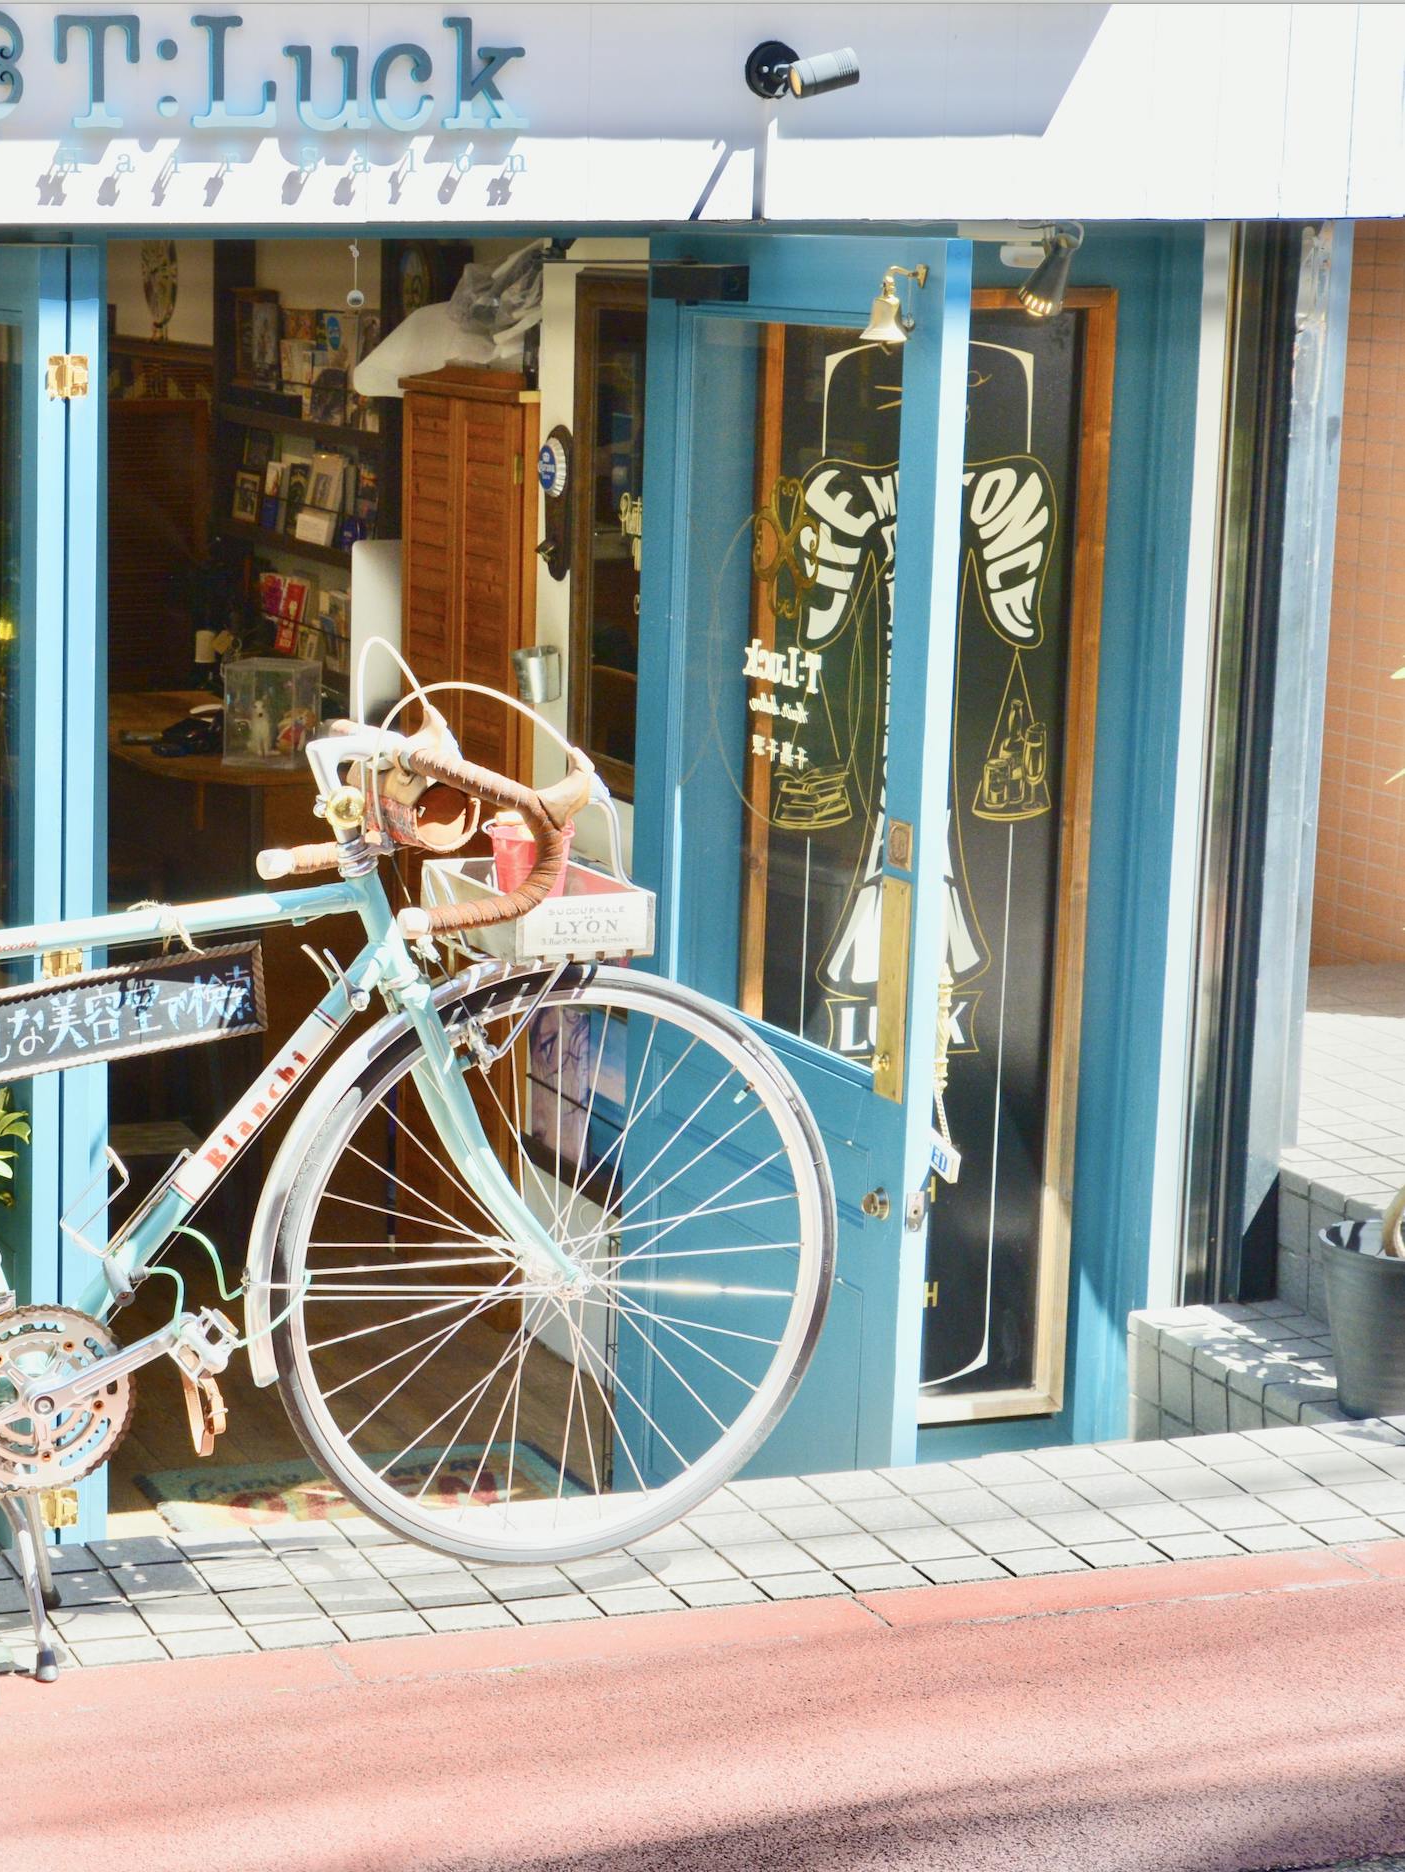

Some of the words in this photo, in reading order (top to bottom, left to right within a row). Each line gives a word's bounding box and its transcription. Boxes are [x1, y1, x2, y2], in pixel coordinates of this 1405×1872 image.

[54, 14, 530, 131] T:Luck
[56, 147, 243, 175] Hair
[299, 147, 527, 175] Salon
[970, 468, 1049, 639] ONCE
[554, 920, 619, 935] LYON
[840, 1002, 967, 1051] LK
[203, 1050, 309, 1173] Bianchi
